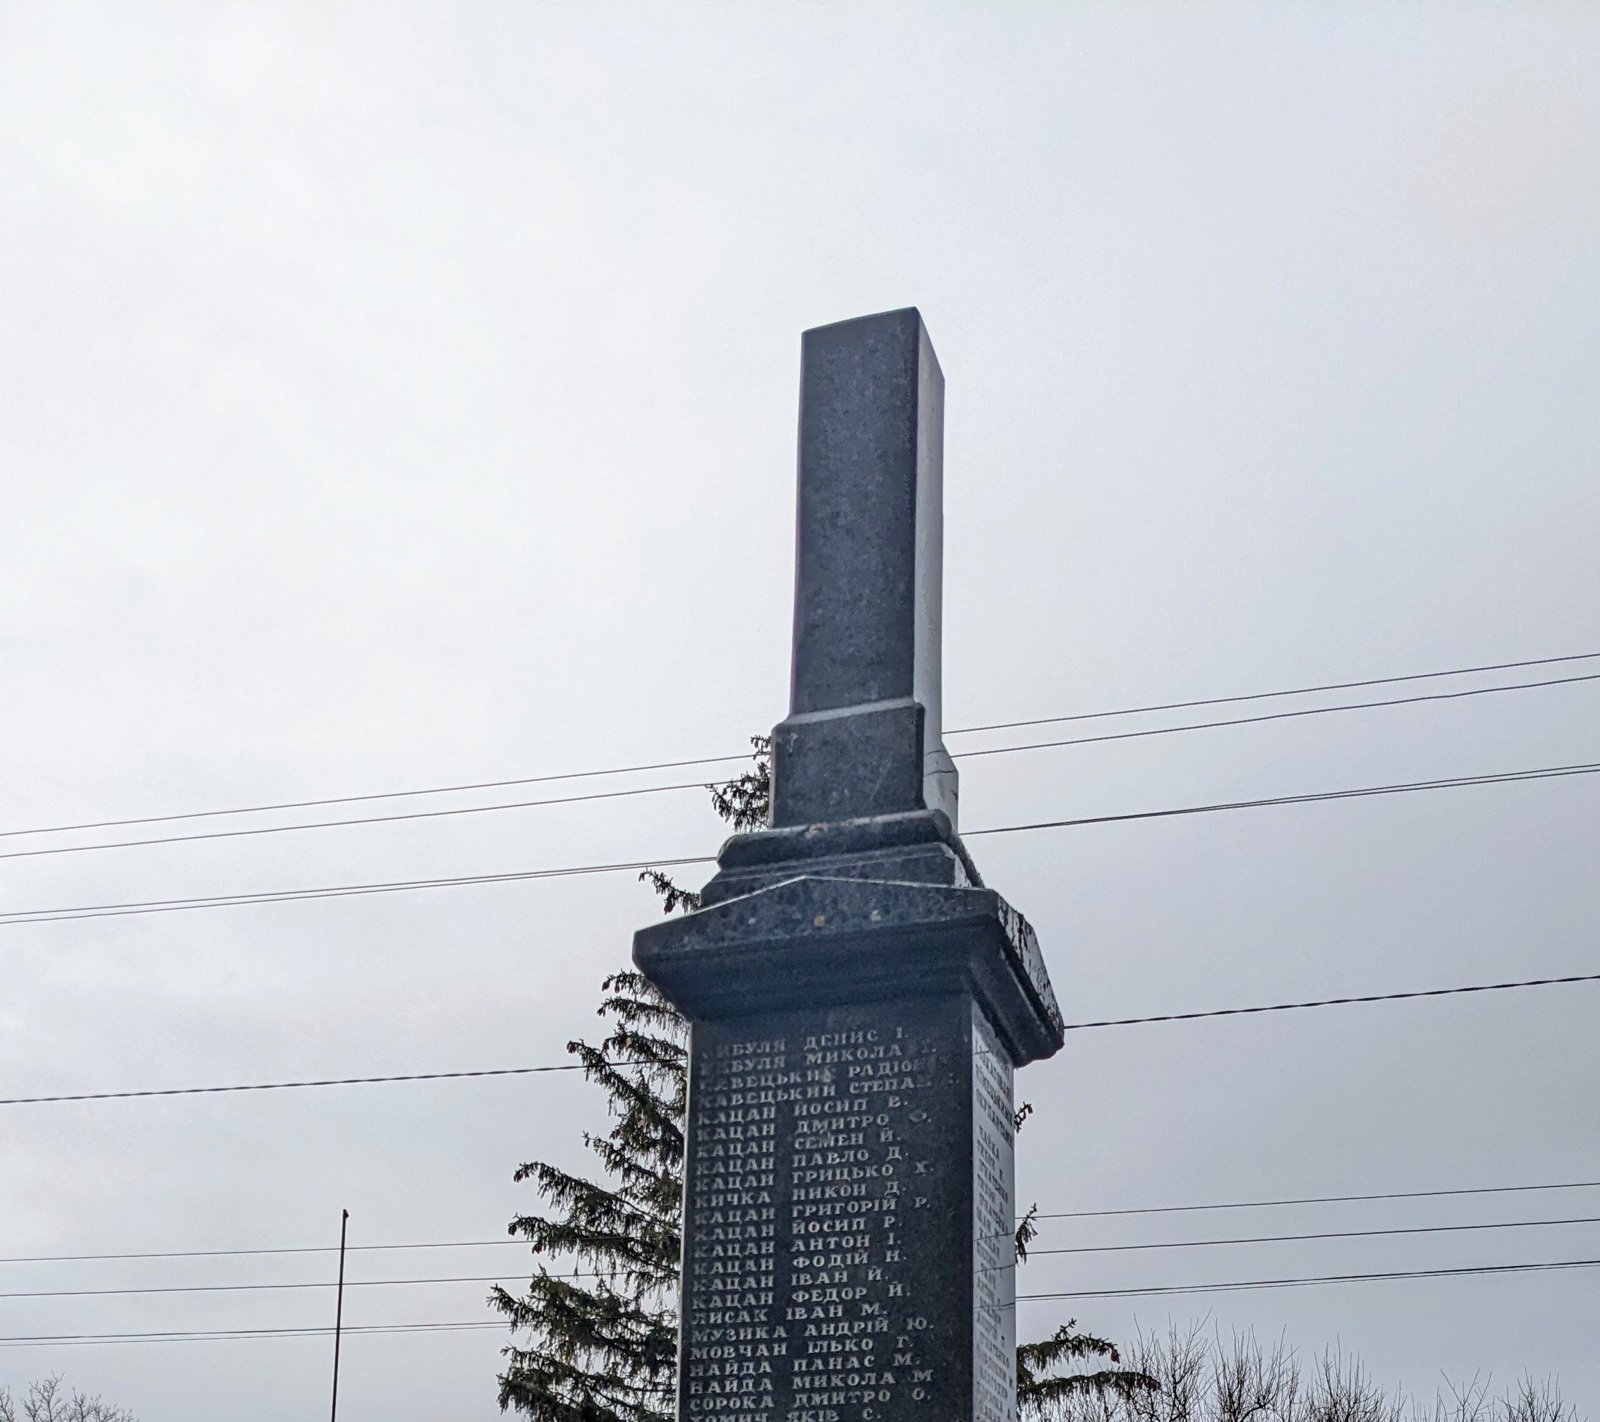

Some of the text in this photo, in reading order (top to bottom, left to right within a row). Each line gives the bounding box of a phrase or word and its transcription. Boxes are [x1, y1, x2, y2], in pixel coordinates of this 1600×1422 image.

[804, 1029, 879, 1051] ДЕНИС
[805, 1044, 903, 1066] МИКОЛА
[697, 1123, 775, 1142] КАЦАН
[796, 1114, 889, 1136] ДМИТРО
[698, 1106, 776, 1126] КАЦАН
[697, 1140, 775, 1159] КАЦАН
[793, 1132, 864, 1151] СЕМЕН
[696, 1157, 775, 1176] КАЦАН
[792, 1149, 869, 1168] ПАВЛО
[695, 1174, 775, 1193] КАЦАН
[791, 1164, 895, 1185] ГРИЦЬКО
[694, 1191, 772, 1209] КИЧКА
[791, 1184, 867, 1202] НИКОН
[694, 1207, 776, 1226] КАЦАН
[791, 1197, 898, 1219] ГРИГОРІЙ
[694, 1224, 775, 1243] КАЦАН
[694, 1241, 775, 1260] КАЦАН
[790, 1234, 871, 1252] АНТОН
[693, 1258, 775, 1276] КАЦАН
[692, 1275, 775, 1293] КАЦАН
[790, 1271, 849, 1287] ІВАН
[692, 1292, 774, 1310] КАЦАН
[791, 1286, 868, 1305] ФЕДОР
[691, 1308, 769, 1326] ЛИСАК
[786, 1304, 844, 1321] ІВАН
[691, 1326, 788, 1344] МУЗИКА
[803, 1317, 889, 1338] АНДРІЙ
[689, 1342, 788, 1361] МОВЧАН
[807, 1337, 874, 1354] ІЛЬКО
[689, 1358, 773, 1377] НАЙДА
[793, 1355, 876, 1373] ПАНАС
[689, 1376, 774, 1395] НАЙДА
[792, 1371, 896, 1390] МИКОЛА
[688, 1395, 775, 1412] СОРОКА
[793, 1389, 892, 1408] ДМИТРО
